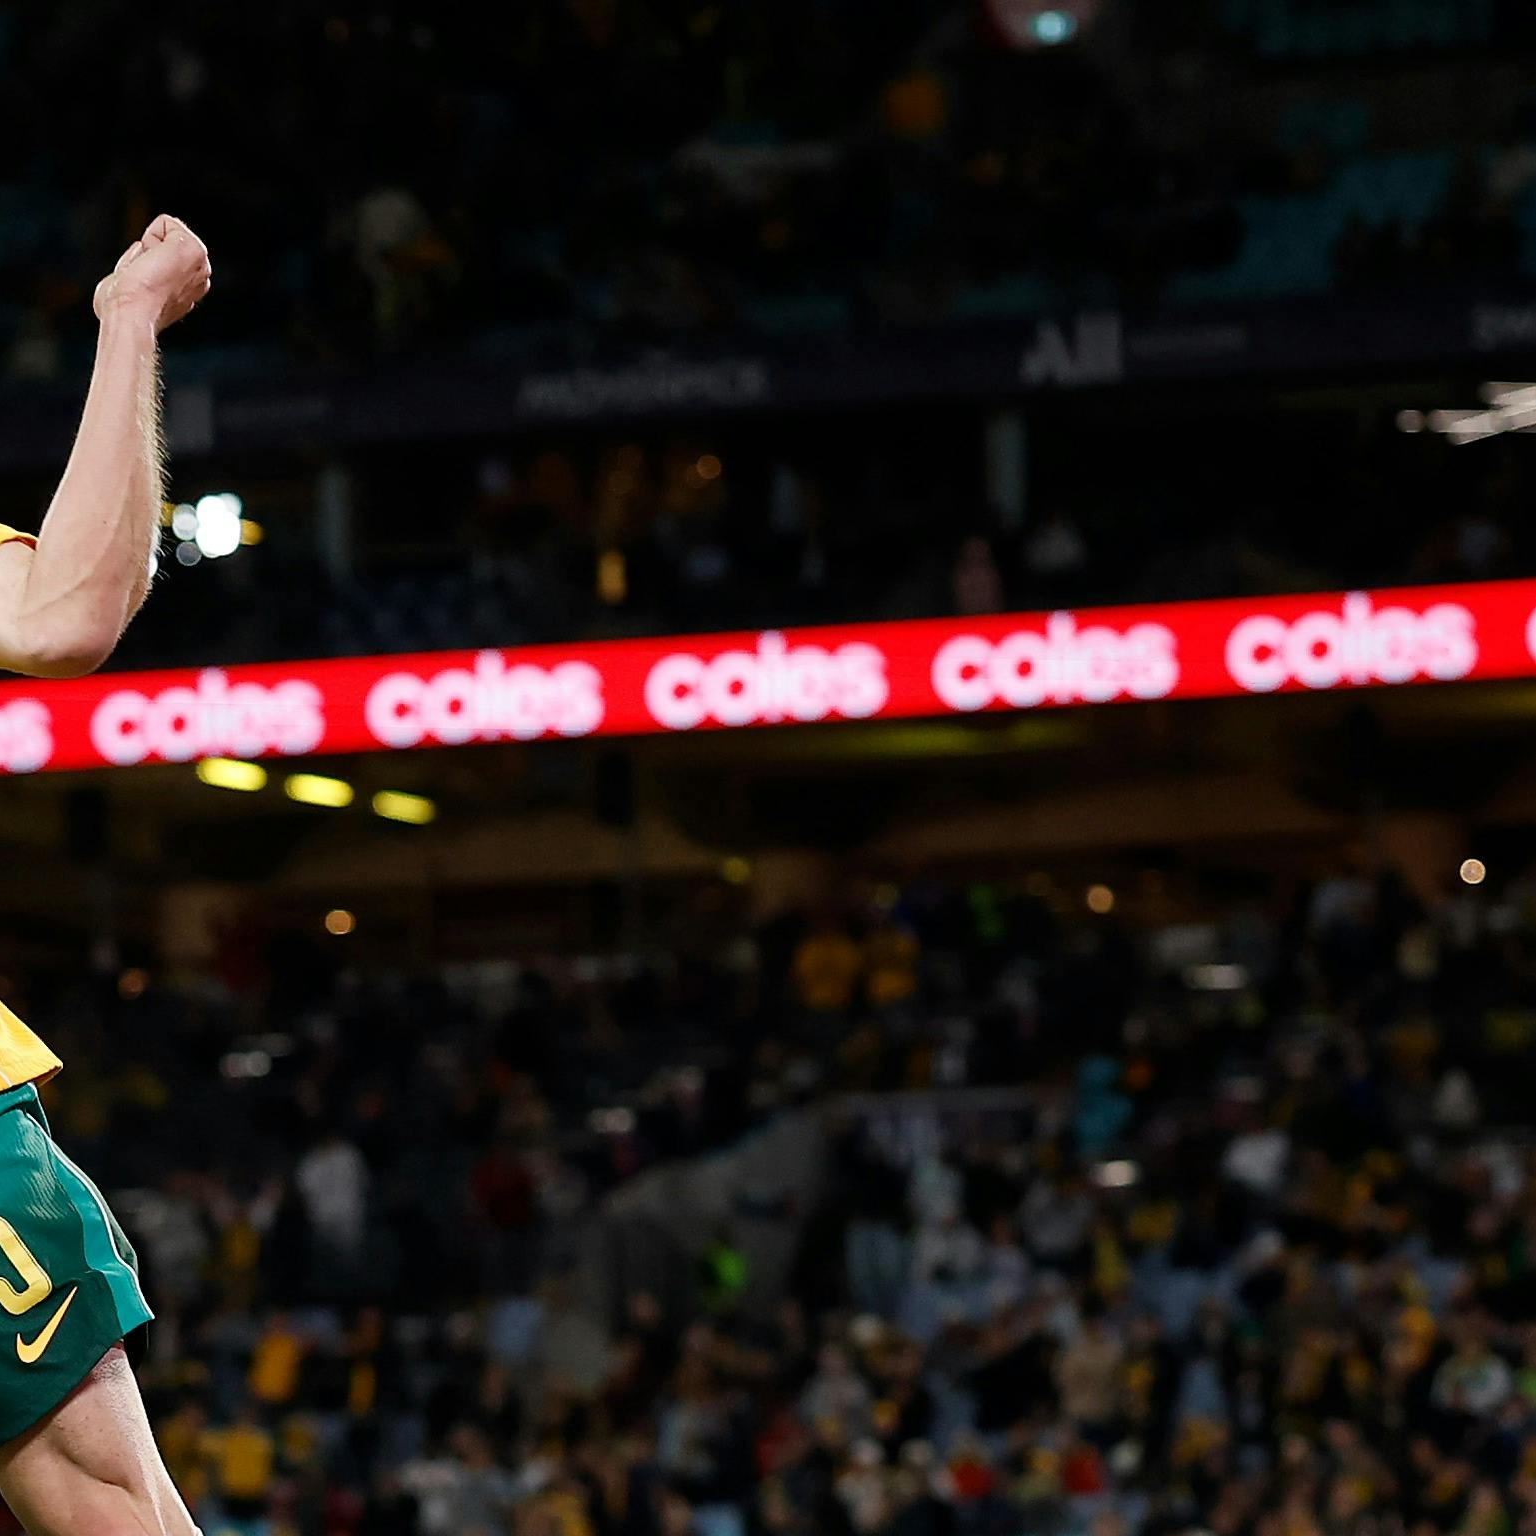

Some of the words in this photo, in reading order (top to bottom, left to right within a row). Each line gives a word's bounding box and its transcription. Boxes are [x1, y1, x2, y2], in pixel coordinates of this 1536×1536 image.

[91, 667, 325, 765] coles
[365, 648, 605, 748] coles
[644, 630, 889, 731] coles
[931, 610, 1179, 712] coles
[1226, 591, 1477, 693] coles
